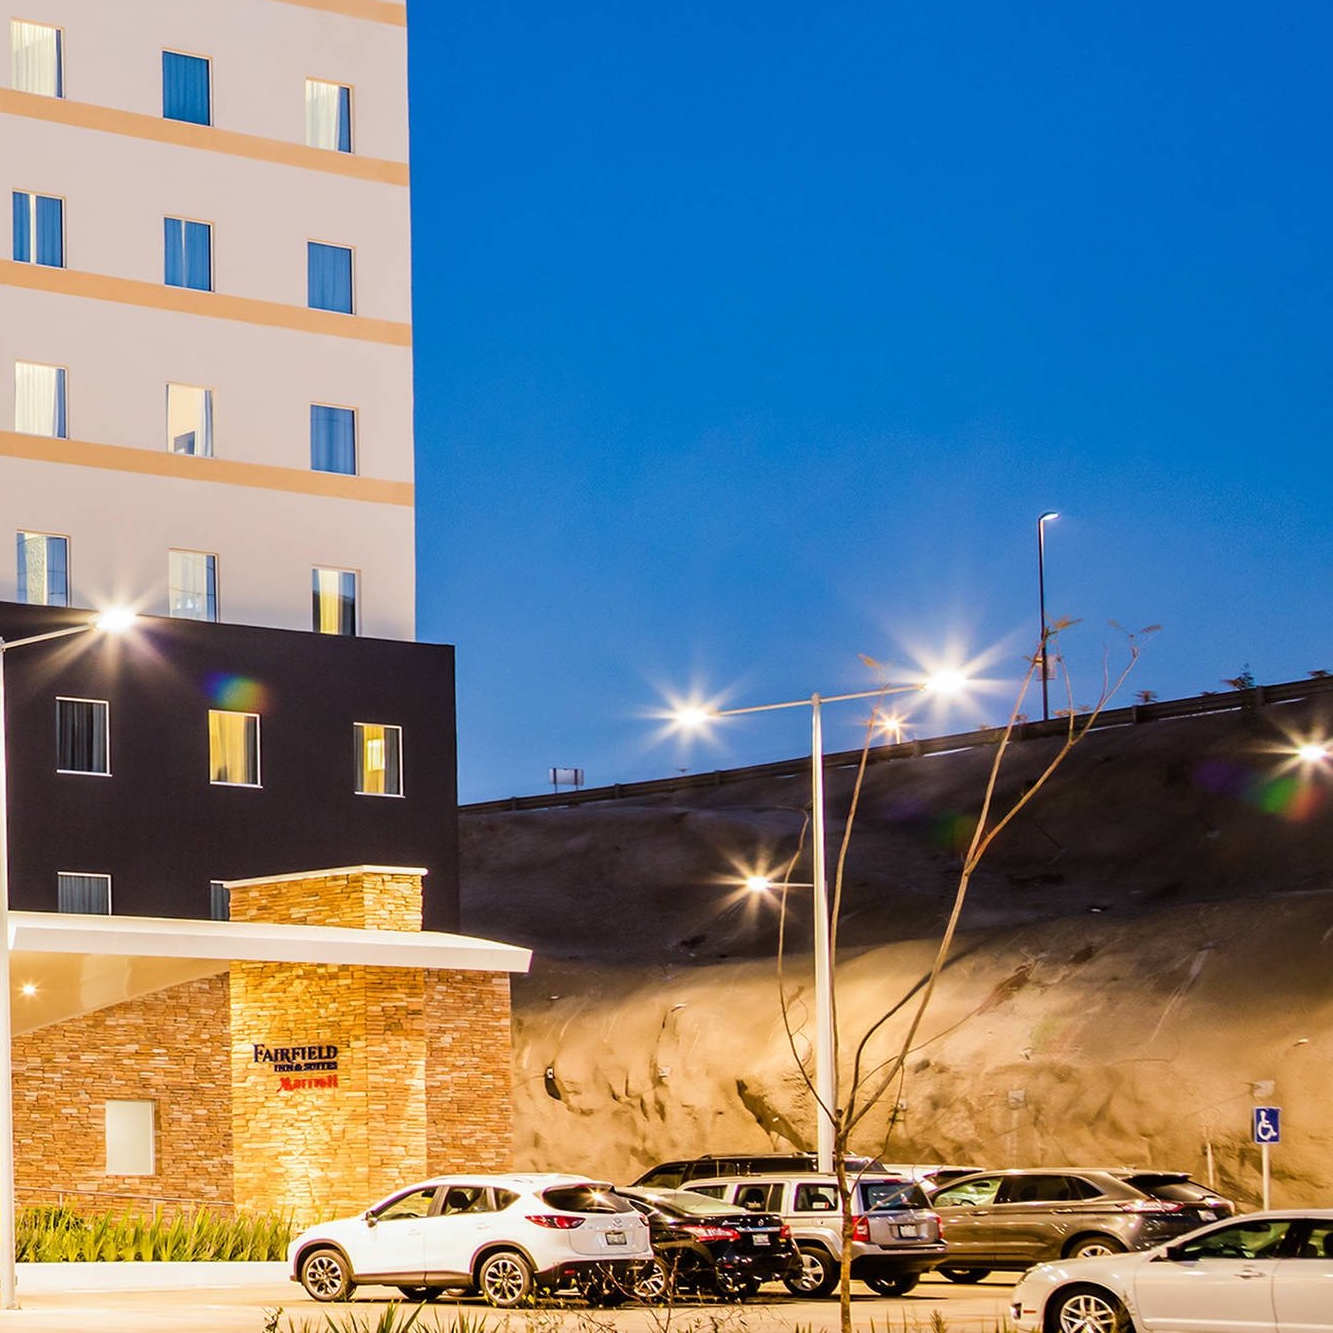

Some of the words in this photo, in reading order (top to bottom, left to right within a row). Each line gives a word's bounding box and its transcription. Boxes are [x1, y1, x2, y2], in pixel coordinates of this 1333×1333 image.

[253, 1044, 338, 1063] FAIRFIELD
[274, 1064, 293, 1072] INN
[303, 1062, 338, 1071] SUITES
